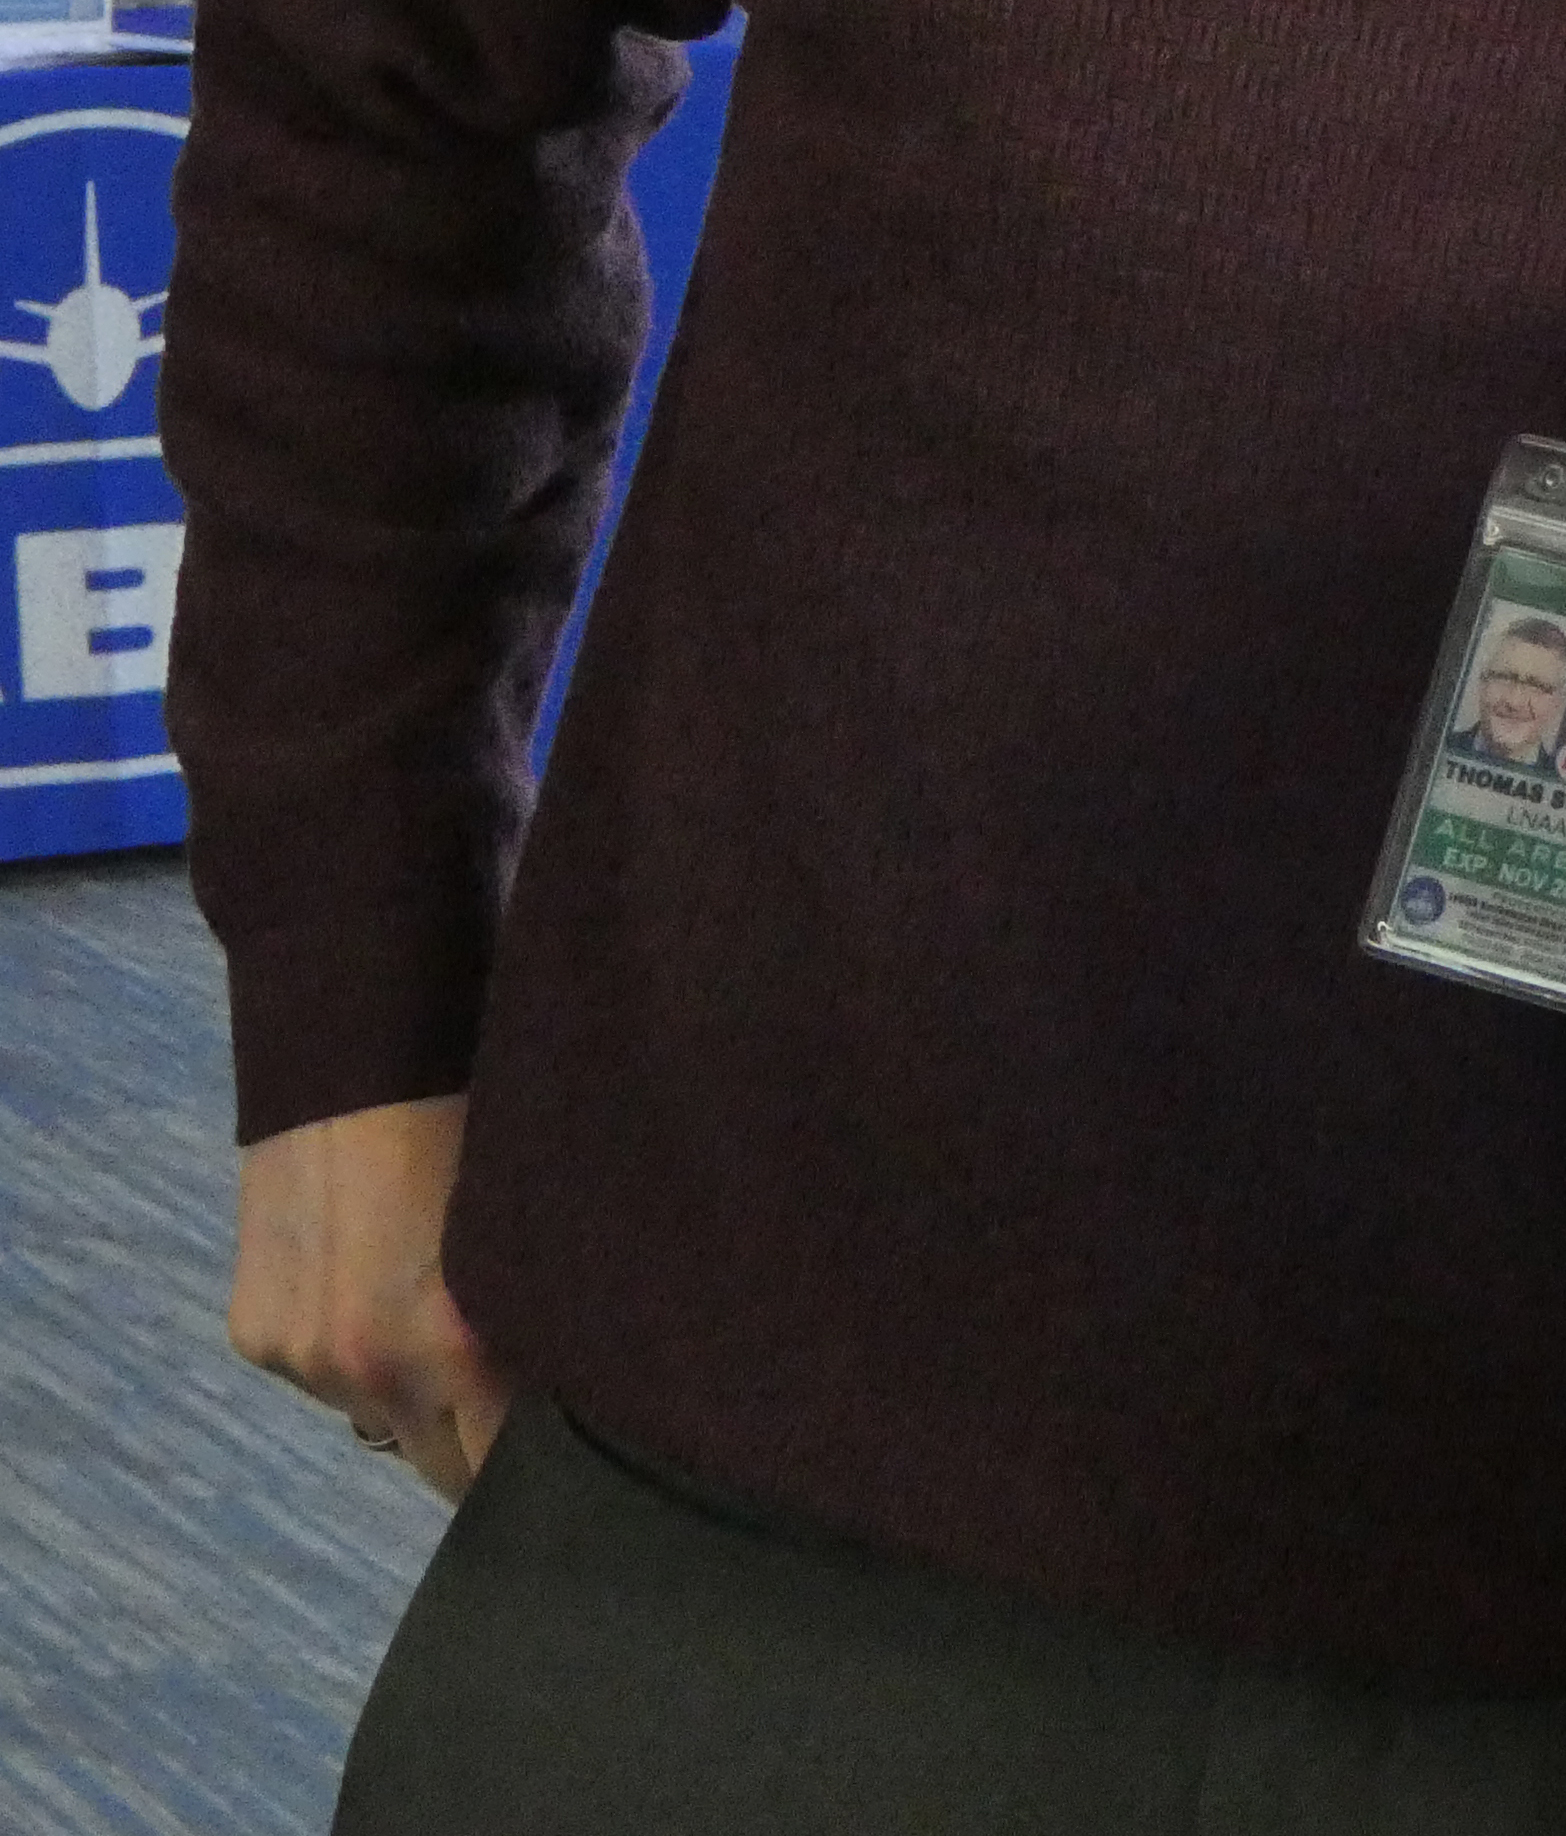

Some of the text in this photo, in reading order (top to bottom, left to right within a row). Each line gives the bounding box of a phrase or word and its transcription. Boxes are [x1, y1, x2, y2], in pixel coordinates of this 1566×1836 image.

[1446, 761, 1544, 803] THOMAS
[1435, 818, 1494, 852] ALL
[1499, 862, 1549, 891] NOV
